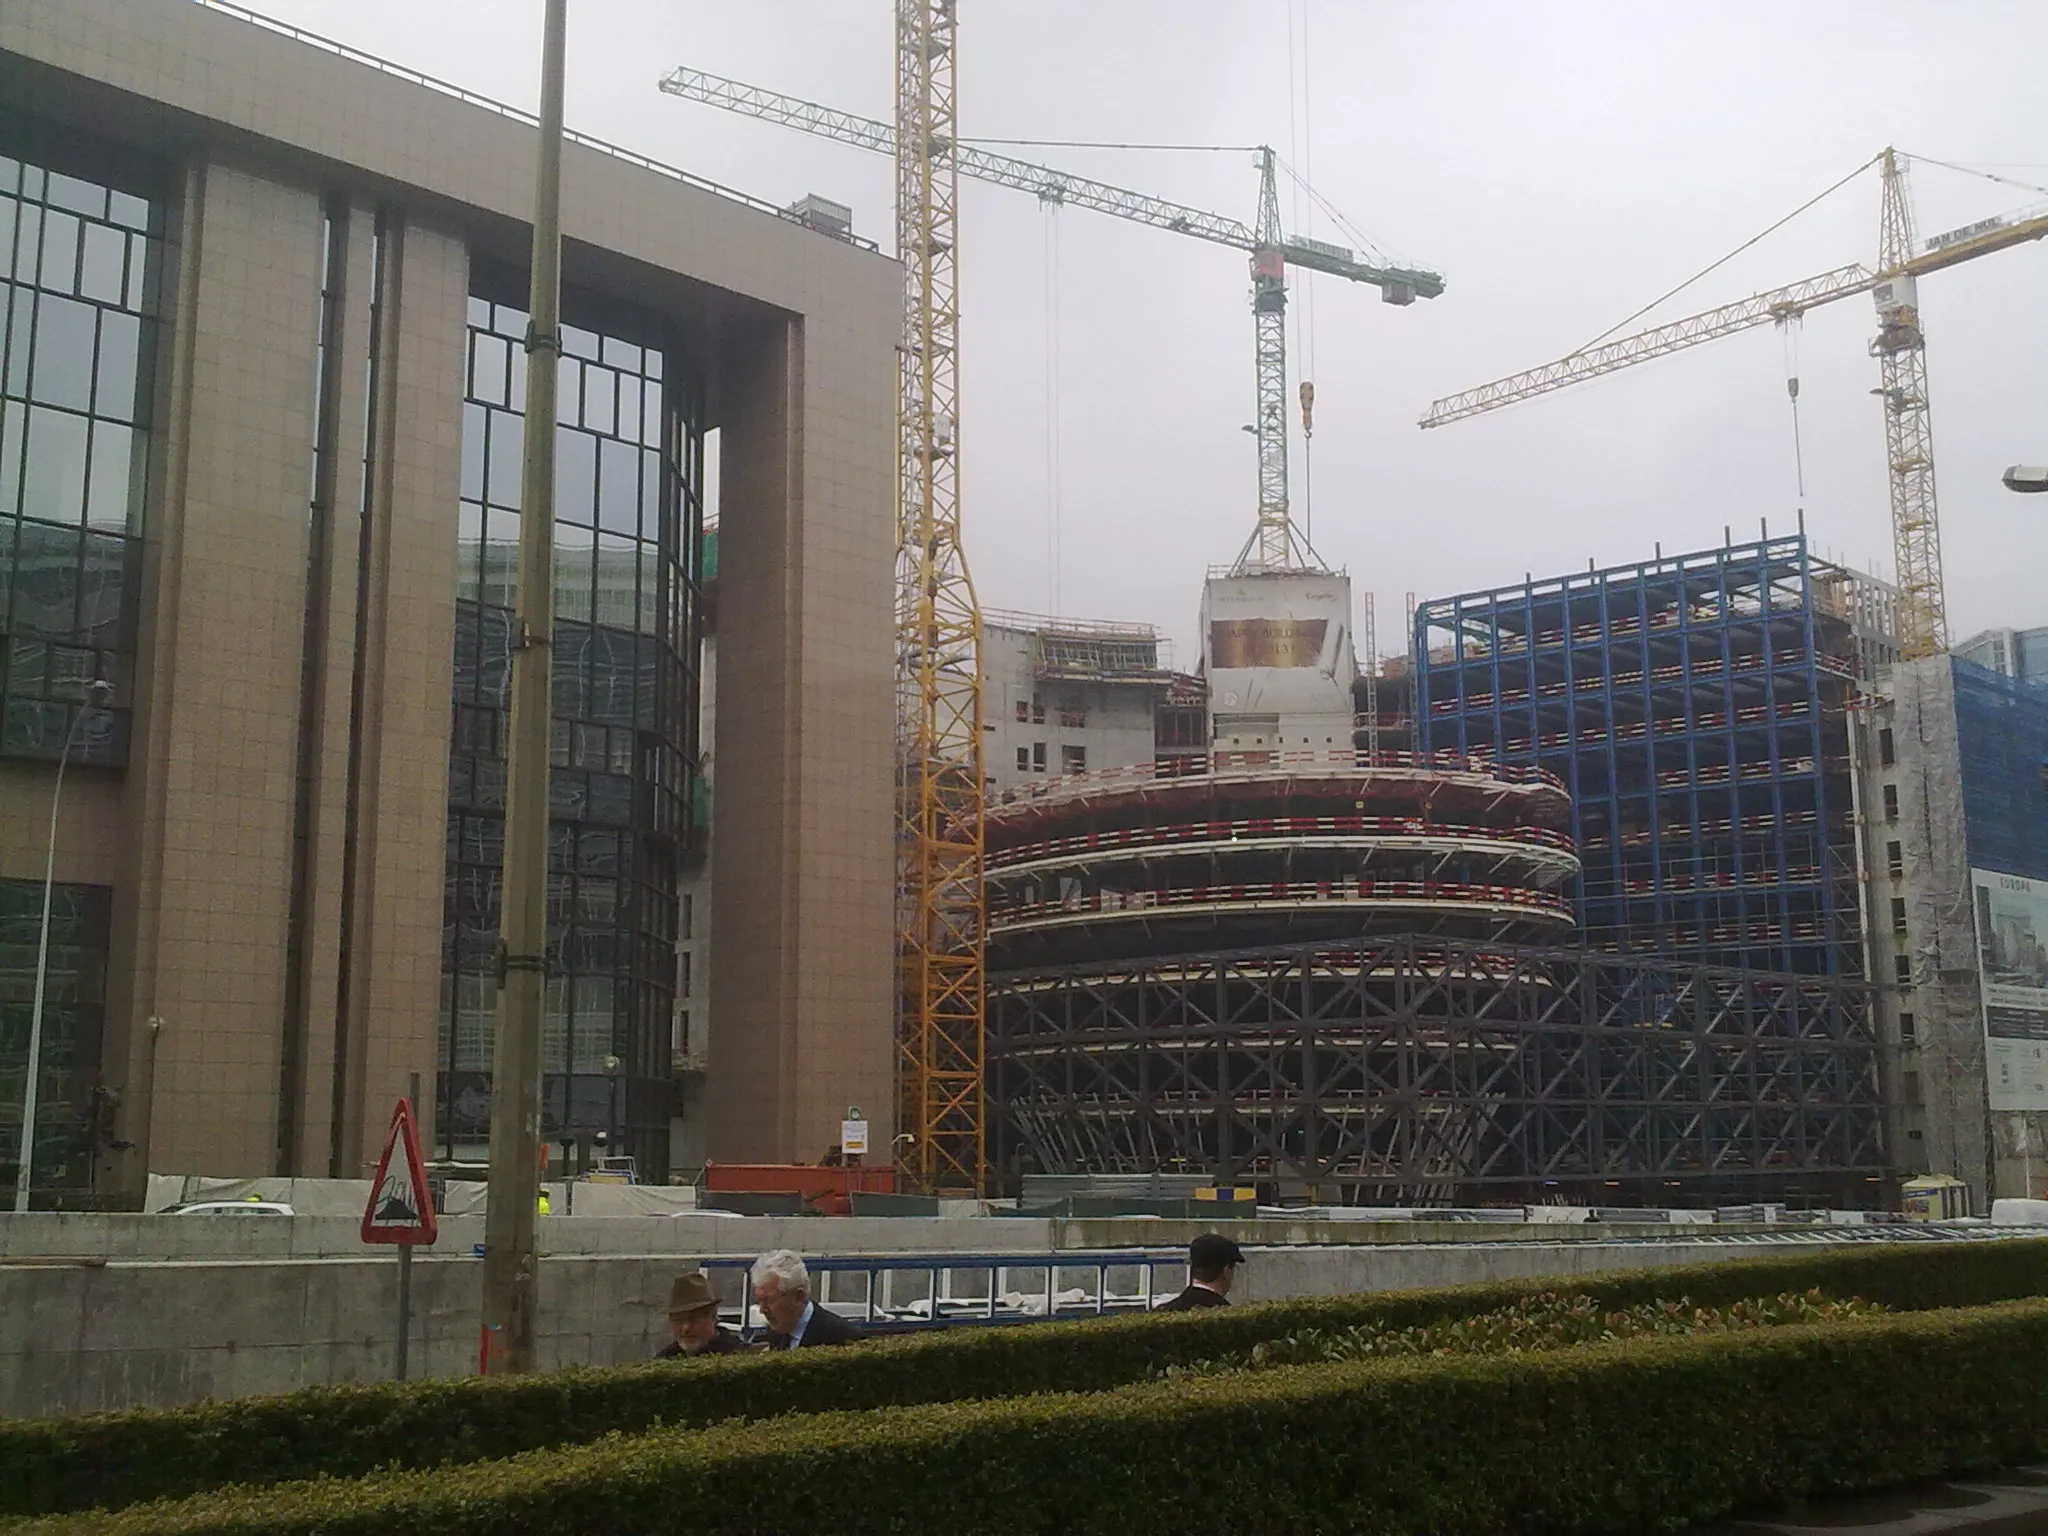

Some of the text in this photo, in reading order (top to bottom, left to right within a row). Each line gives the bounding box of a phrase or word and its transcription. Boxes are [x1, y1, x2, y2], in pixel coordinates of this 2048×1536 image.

[1929, 232, 1950, 246] JAN
[1954, 226, 1972, 240] DE
[2000, 876, 2031, 892] EUROPA
